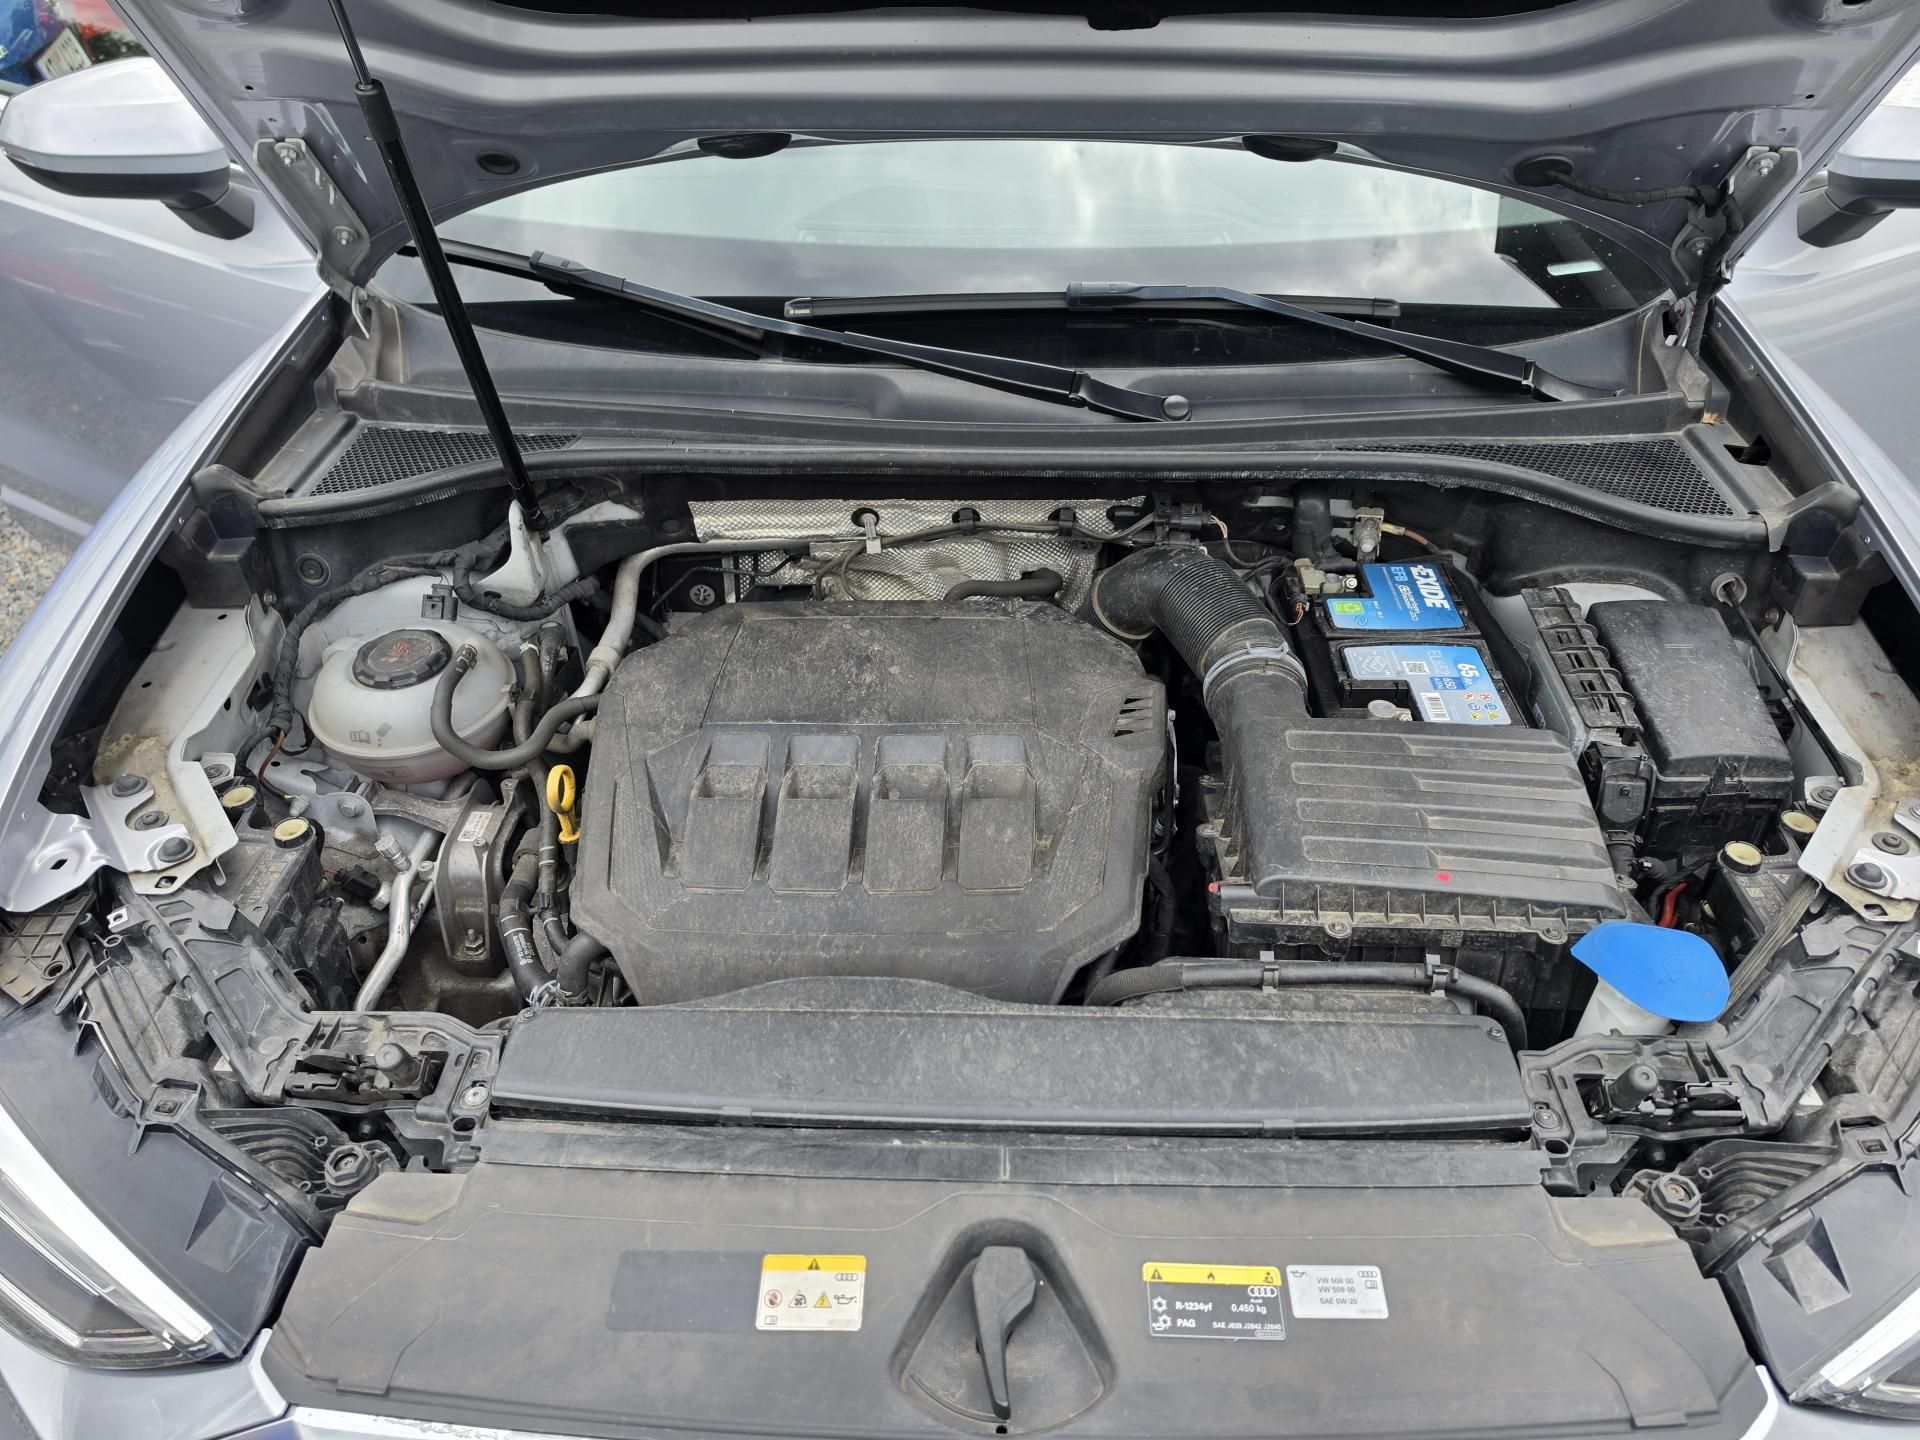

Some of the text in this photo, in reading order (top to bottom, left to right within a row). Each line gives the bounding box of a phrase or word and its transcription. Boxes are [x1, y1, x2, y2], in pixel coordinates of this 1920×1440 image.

[1390, 567, 1408, 581] EFB
[1410, 565, 1450, 610] EXIDE
[1428, 650, 1449, 675] EL652
[1458, 663, 1480, 678] 65
[1443, 677, 1457, 690] 650
[1317, 1277, 1329, 1285] VW
[1175, 1301, 1213, 1313] R-1234yf
[1231, 1303, 1267, 1315] 0,450 kg
[1176, 1319, 1196, 1328] PAG
